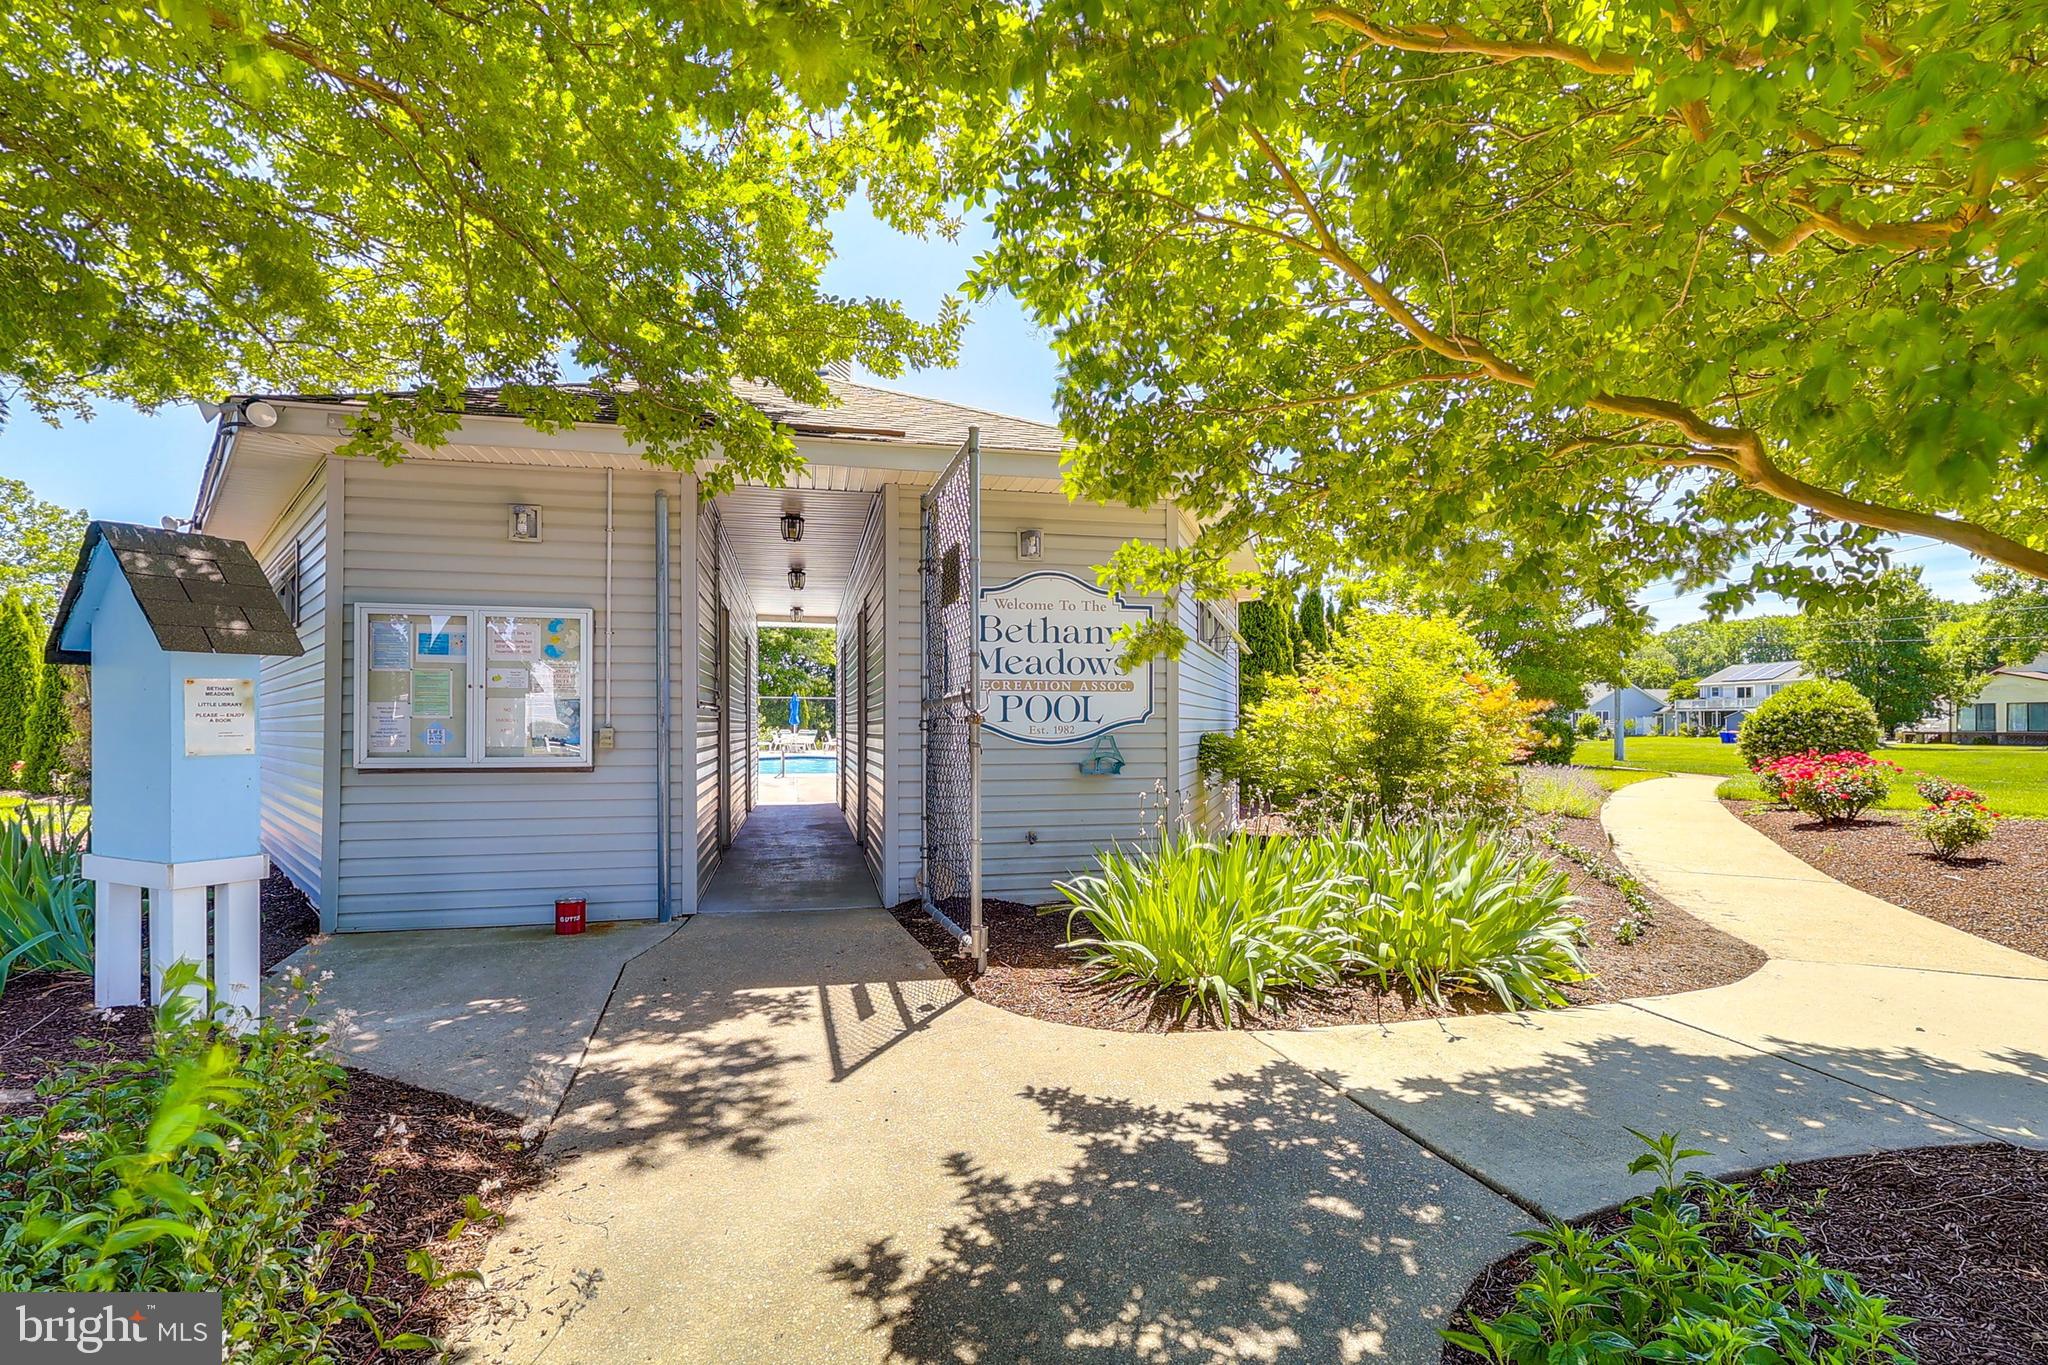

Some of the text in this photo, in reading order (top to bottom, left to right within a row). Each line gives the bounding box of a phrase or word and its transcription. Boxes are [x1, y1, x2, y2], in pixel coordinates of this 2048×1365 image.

[994, 598, 1107, 612] Welcome To The
[979, 614, 1123, 652] Bethany
[979, 680, 1131, 692] ECREATION ASSOC.
[998, 694, 1104, 724] POOL
[1029, 725, 1076, 735] Est. 1982
